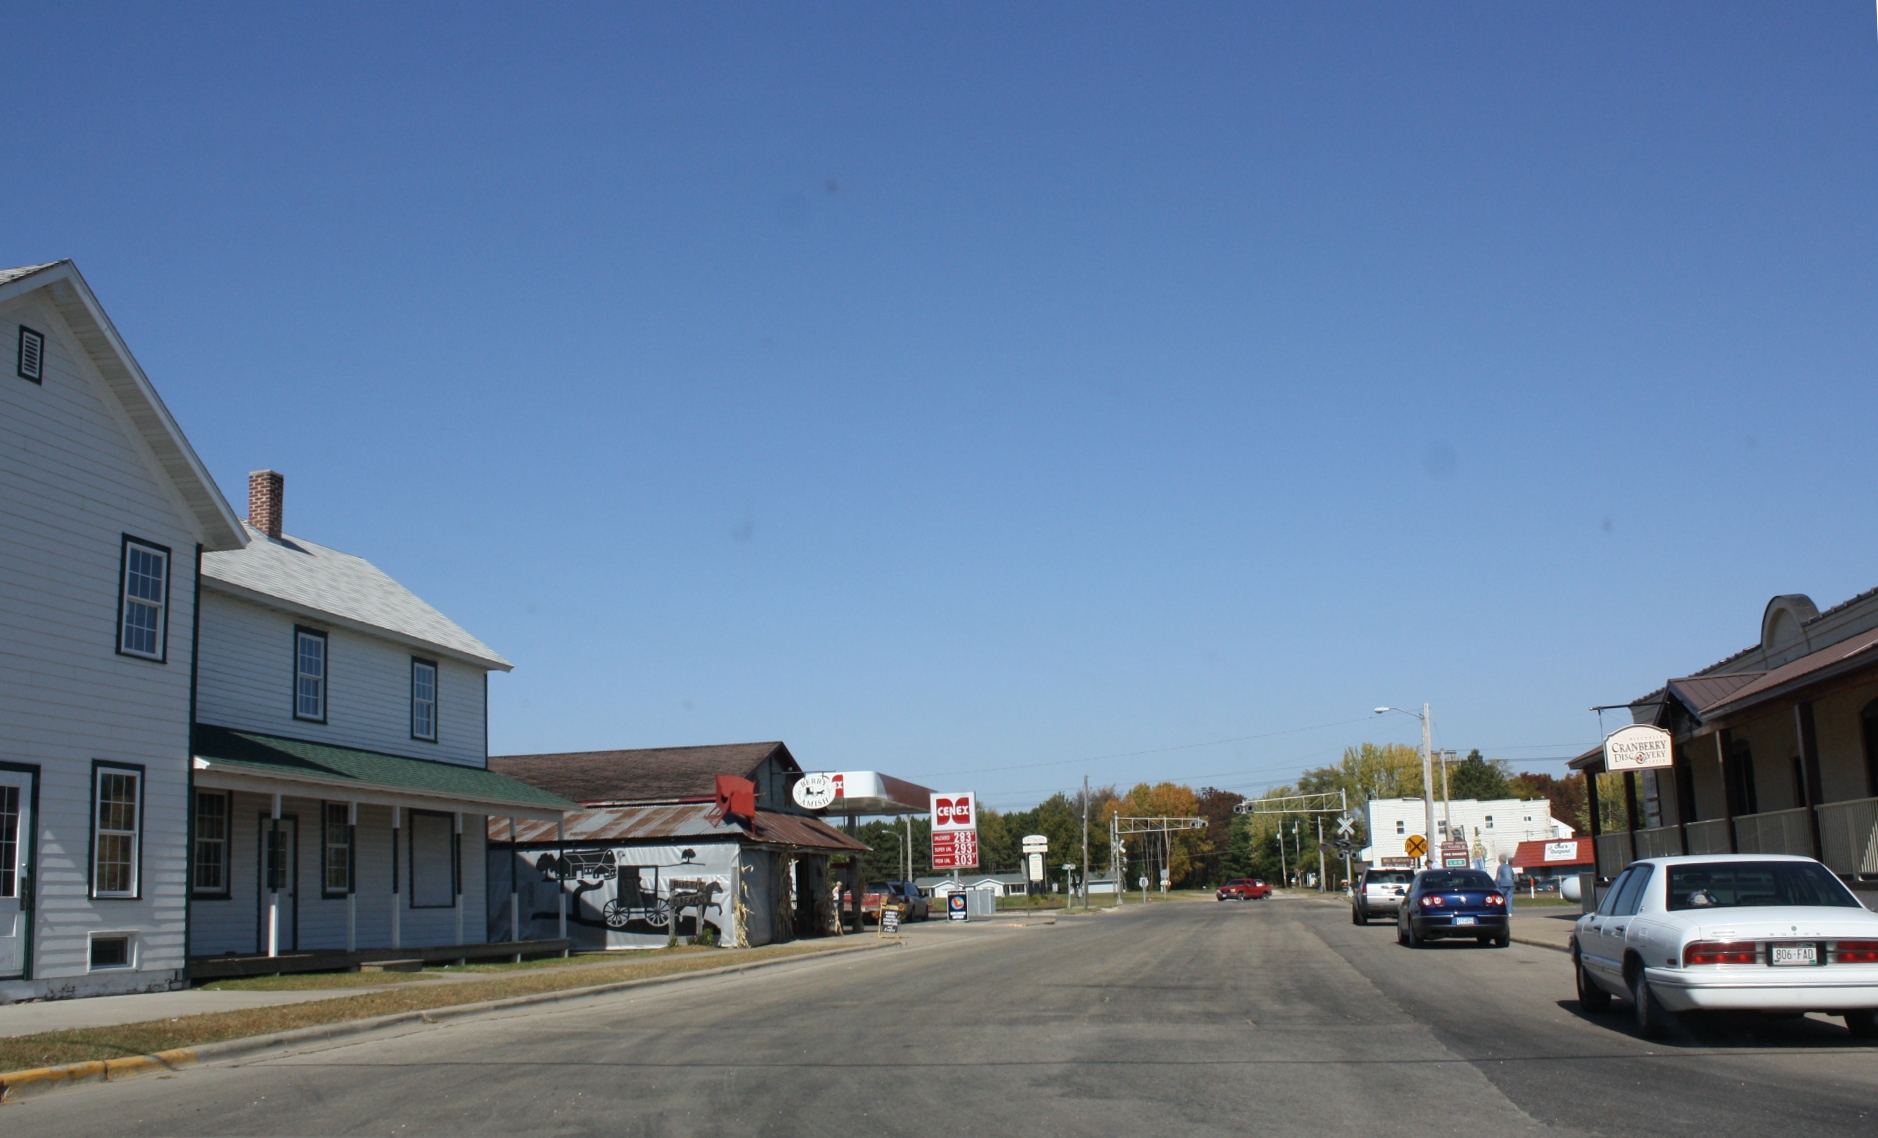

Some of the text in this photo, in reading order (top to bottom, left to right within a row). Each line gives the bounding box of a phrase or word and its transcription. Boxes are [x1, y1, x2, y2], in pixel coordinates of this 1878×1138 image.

[1611, 739, 1667, 753] CRANBERRY
[1613, 750, 1666, 764] DISCOVERY
[800, 777, 827, 788] BERRY
[800, 797, 829, 807] AMISH
[937, 805, 970, 816] CENEX
[674, 880, 706, 891] RUSTIC
[1775, 948, 1814, 960] 806-FAD
